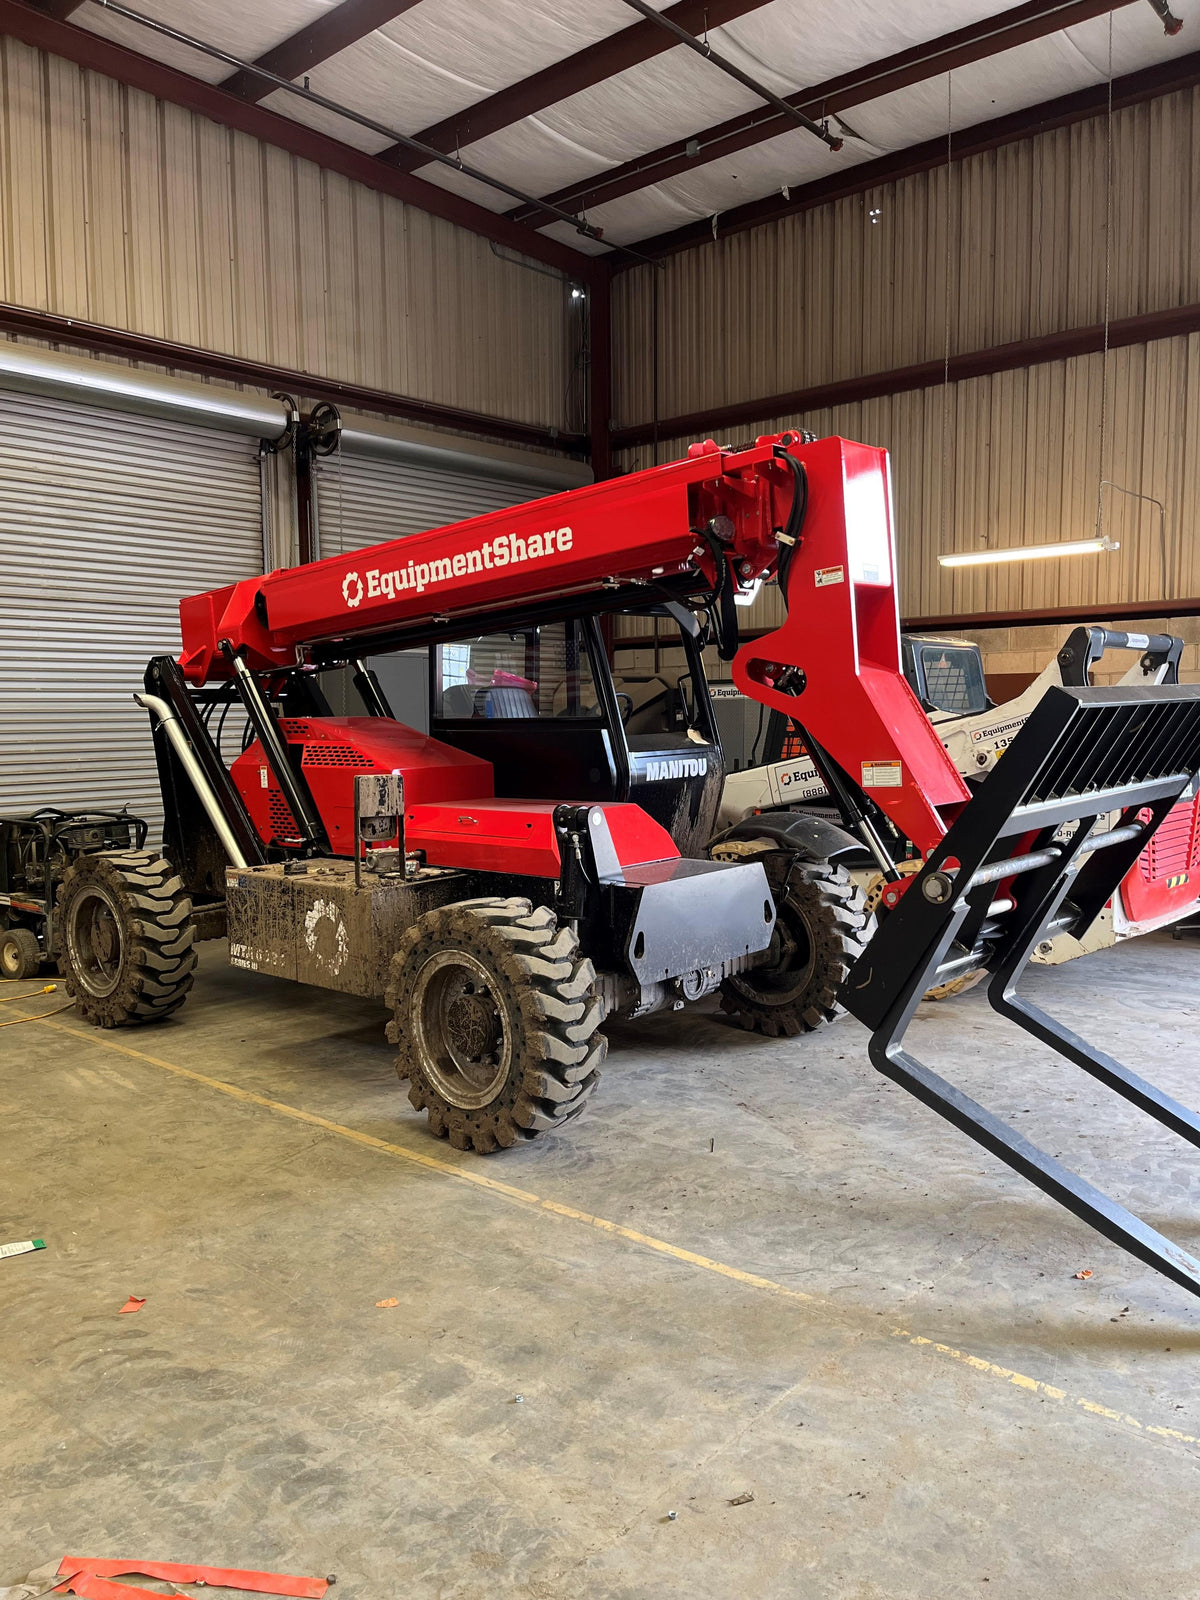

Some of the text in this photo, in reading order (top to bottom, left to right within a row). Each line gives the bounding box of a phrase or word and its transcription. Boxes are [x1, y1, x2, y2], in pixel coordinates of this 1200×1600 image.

[366, 526, 573, 599] EquipmentShare
[646, 757, 707, 781] MANITOU
[802, 785, 827, 799] (888)
